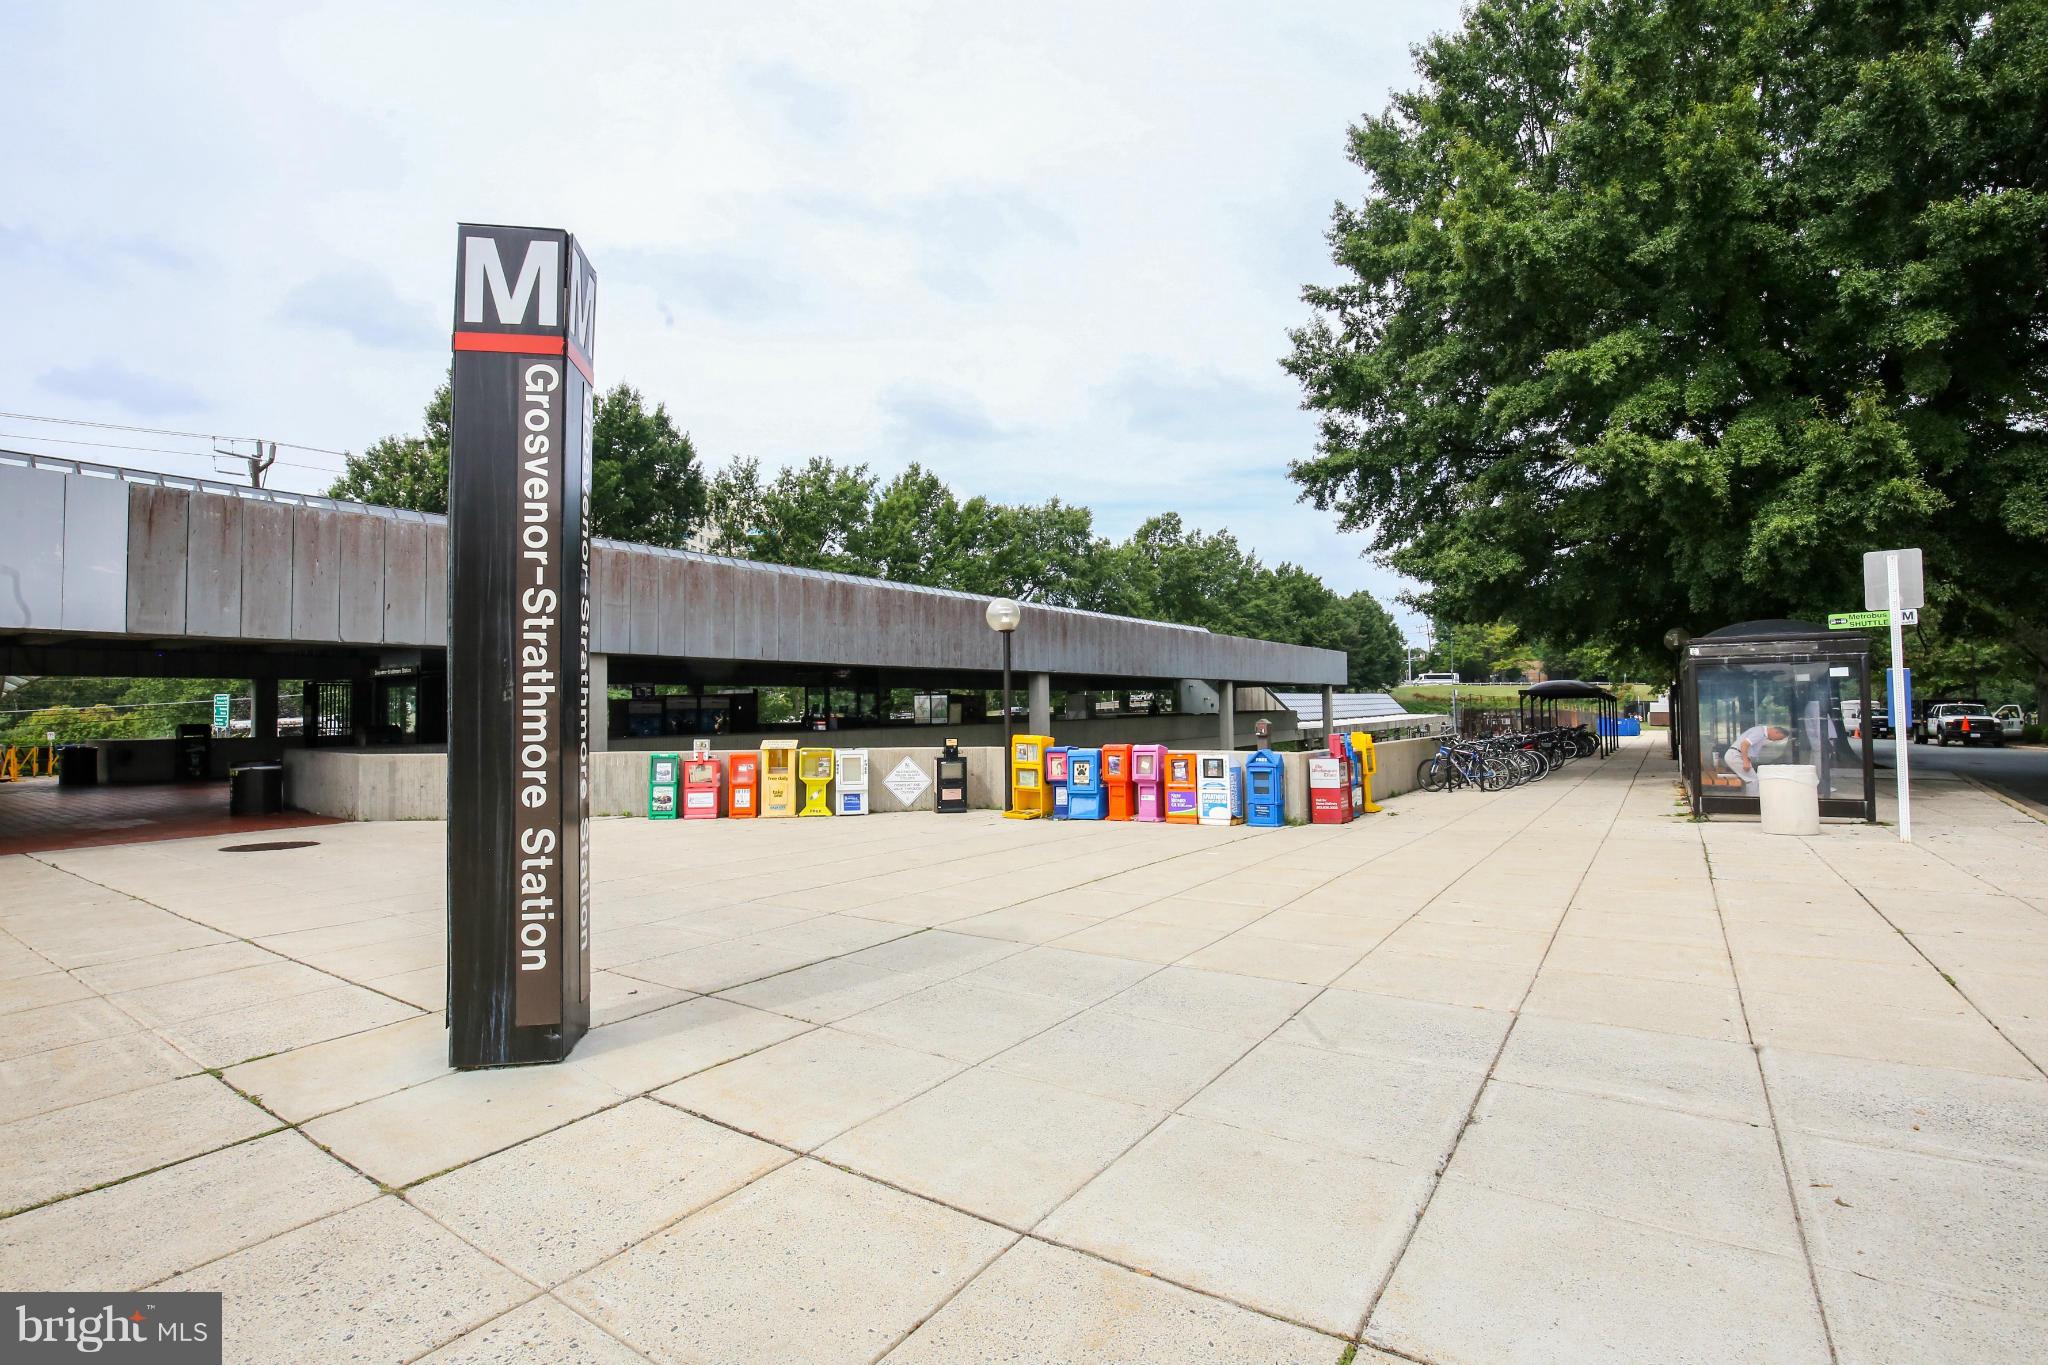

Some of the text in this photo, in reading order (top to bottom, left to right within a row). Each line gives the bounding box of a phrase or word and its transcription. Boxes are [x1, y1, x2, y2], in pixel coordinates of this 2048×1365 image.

[464, 236, 559, 327] M
[569, 247, 596, 360] M
[1848, 612, 1887, 620] Metrobus
[1849, 619, 1889, 627] SHUTTLE
[1902, 611, 1914, 620] M
[520, 363, 560, 971] Grosvenor-Strathmore Station
[579, 816, 590, 952] Station
